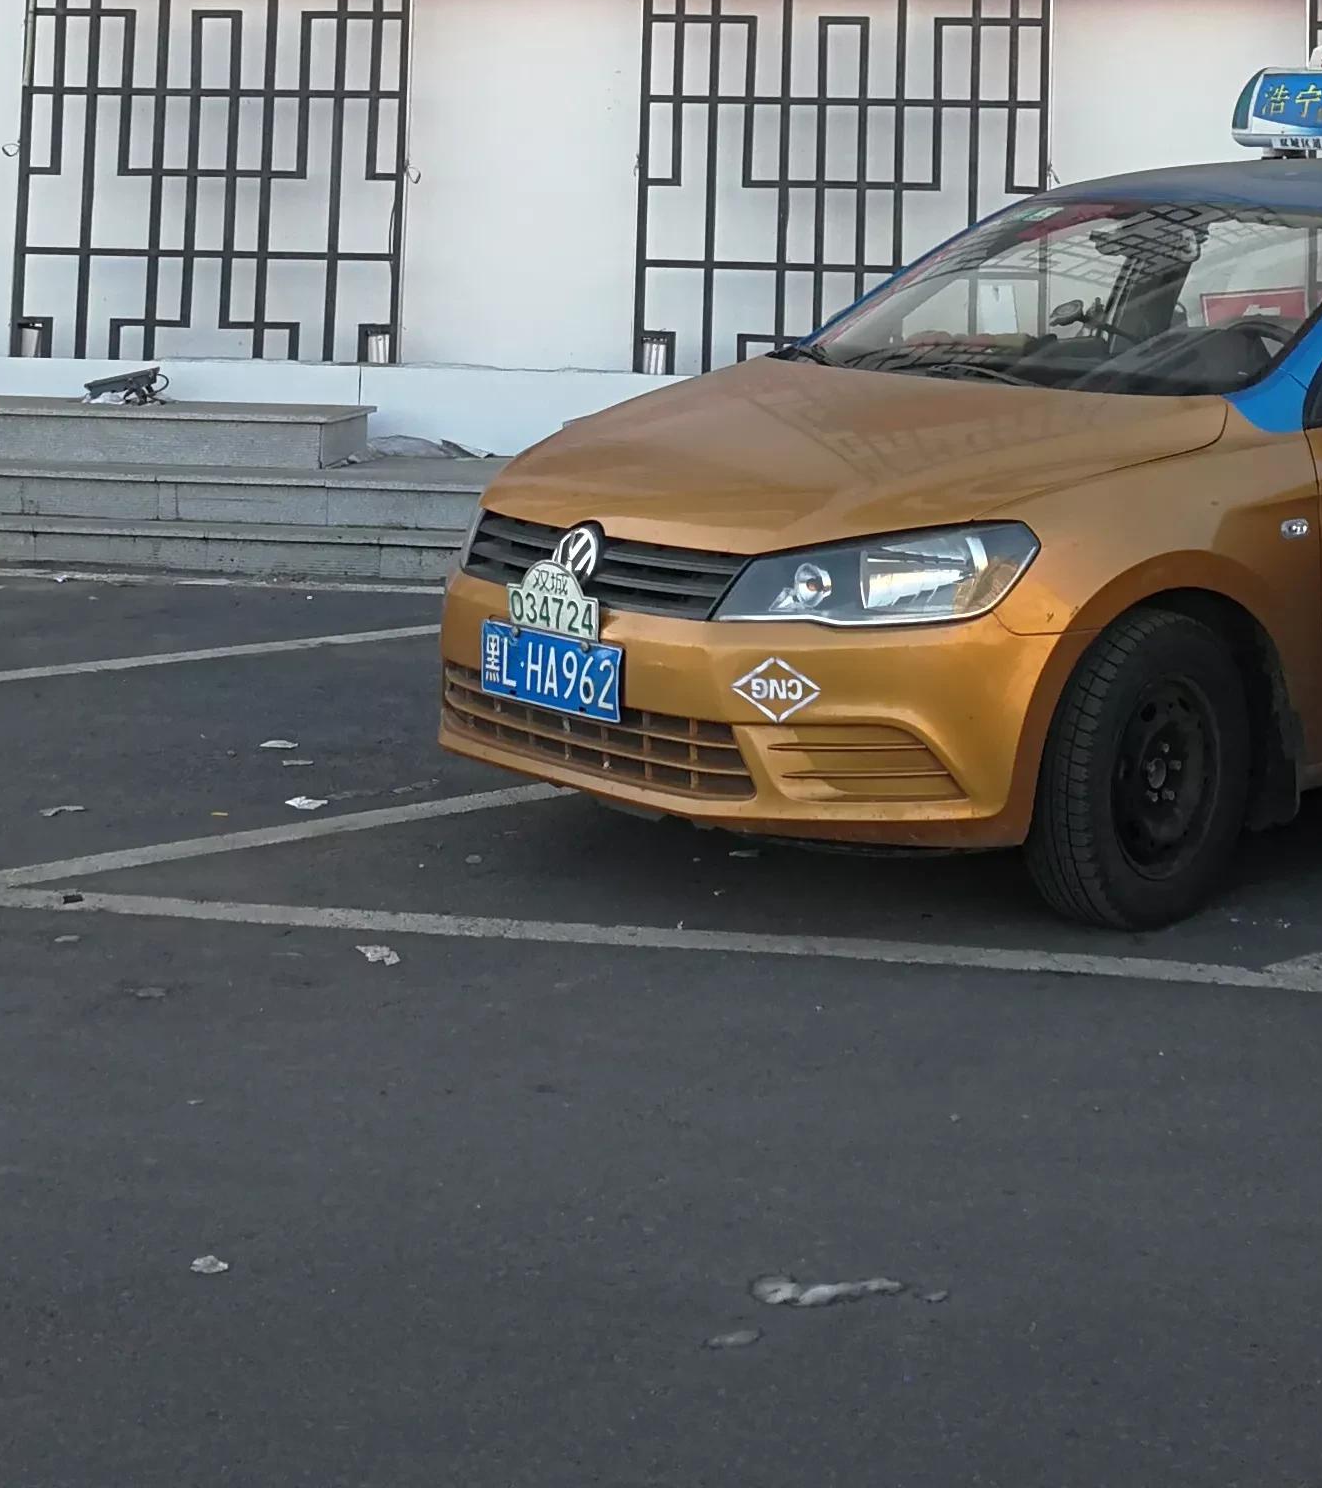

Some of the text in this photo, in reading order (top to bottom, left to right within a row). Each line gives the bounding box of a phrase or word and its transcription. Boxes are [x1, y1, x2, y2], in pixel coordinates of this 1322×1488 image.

[532, 568, 572, 596] 双城
[510, 589, 595, 636] 034724
[750, 678, 803, 701] CNG
